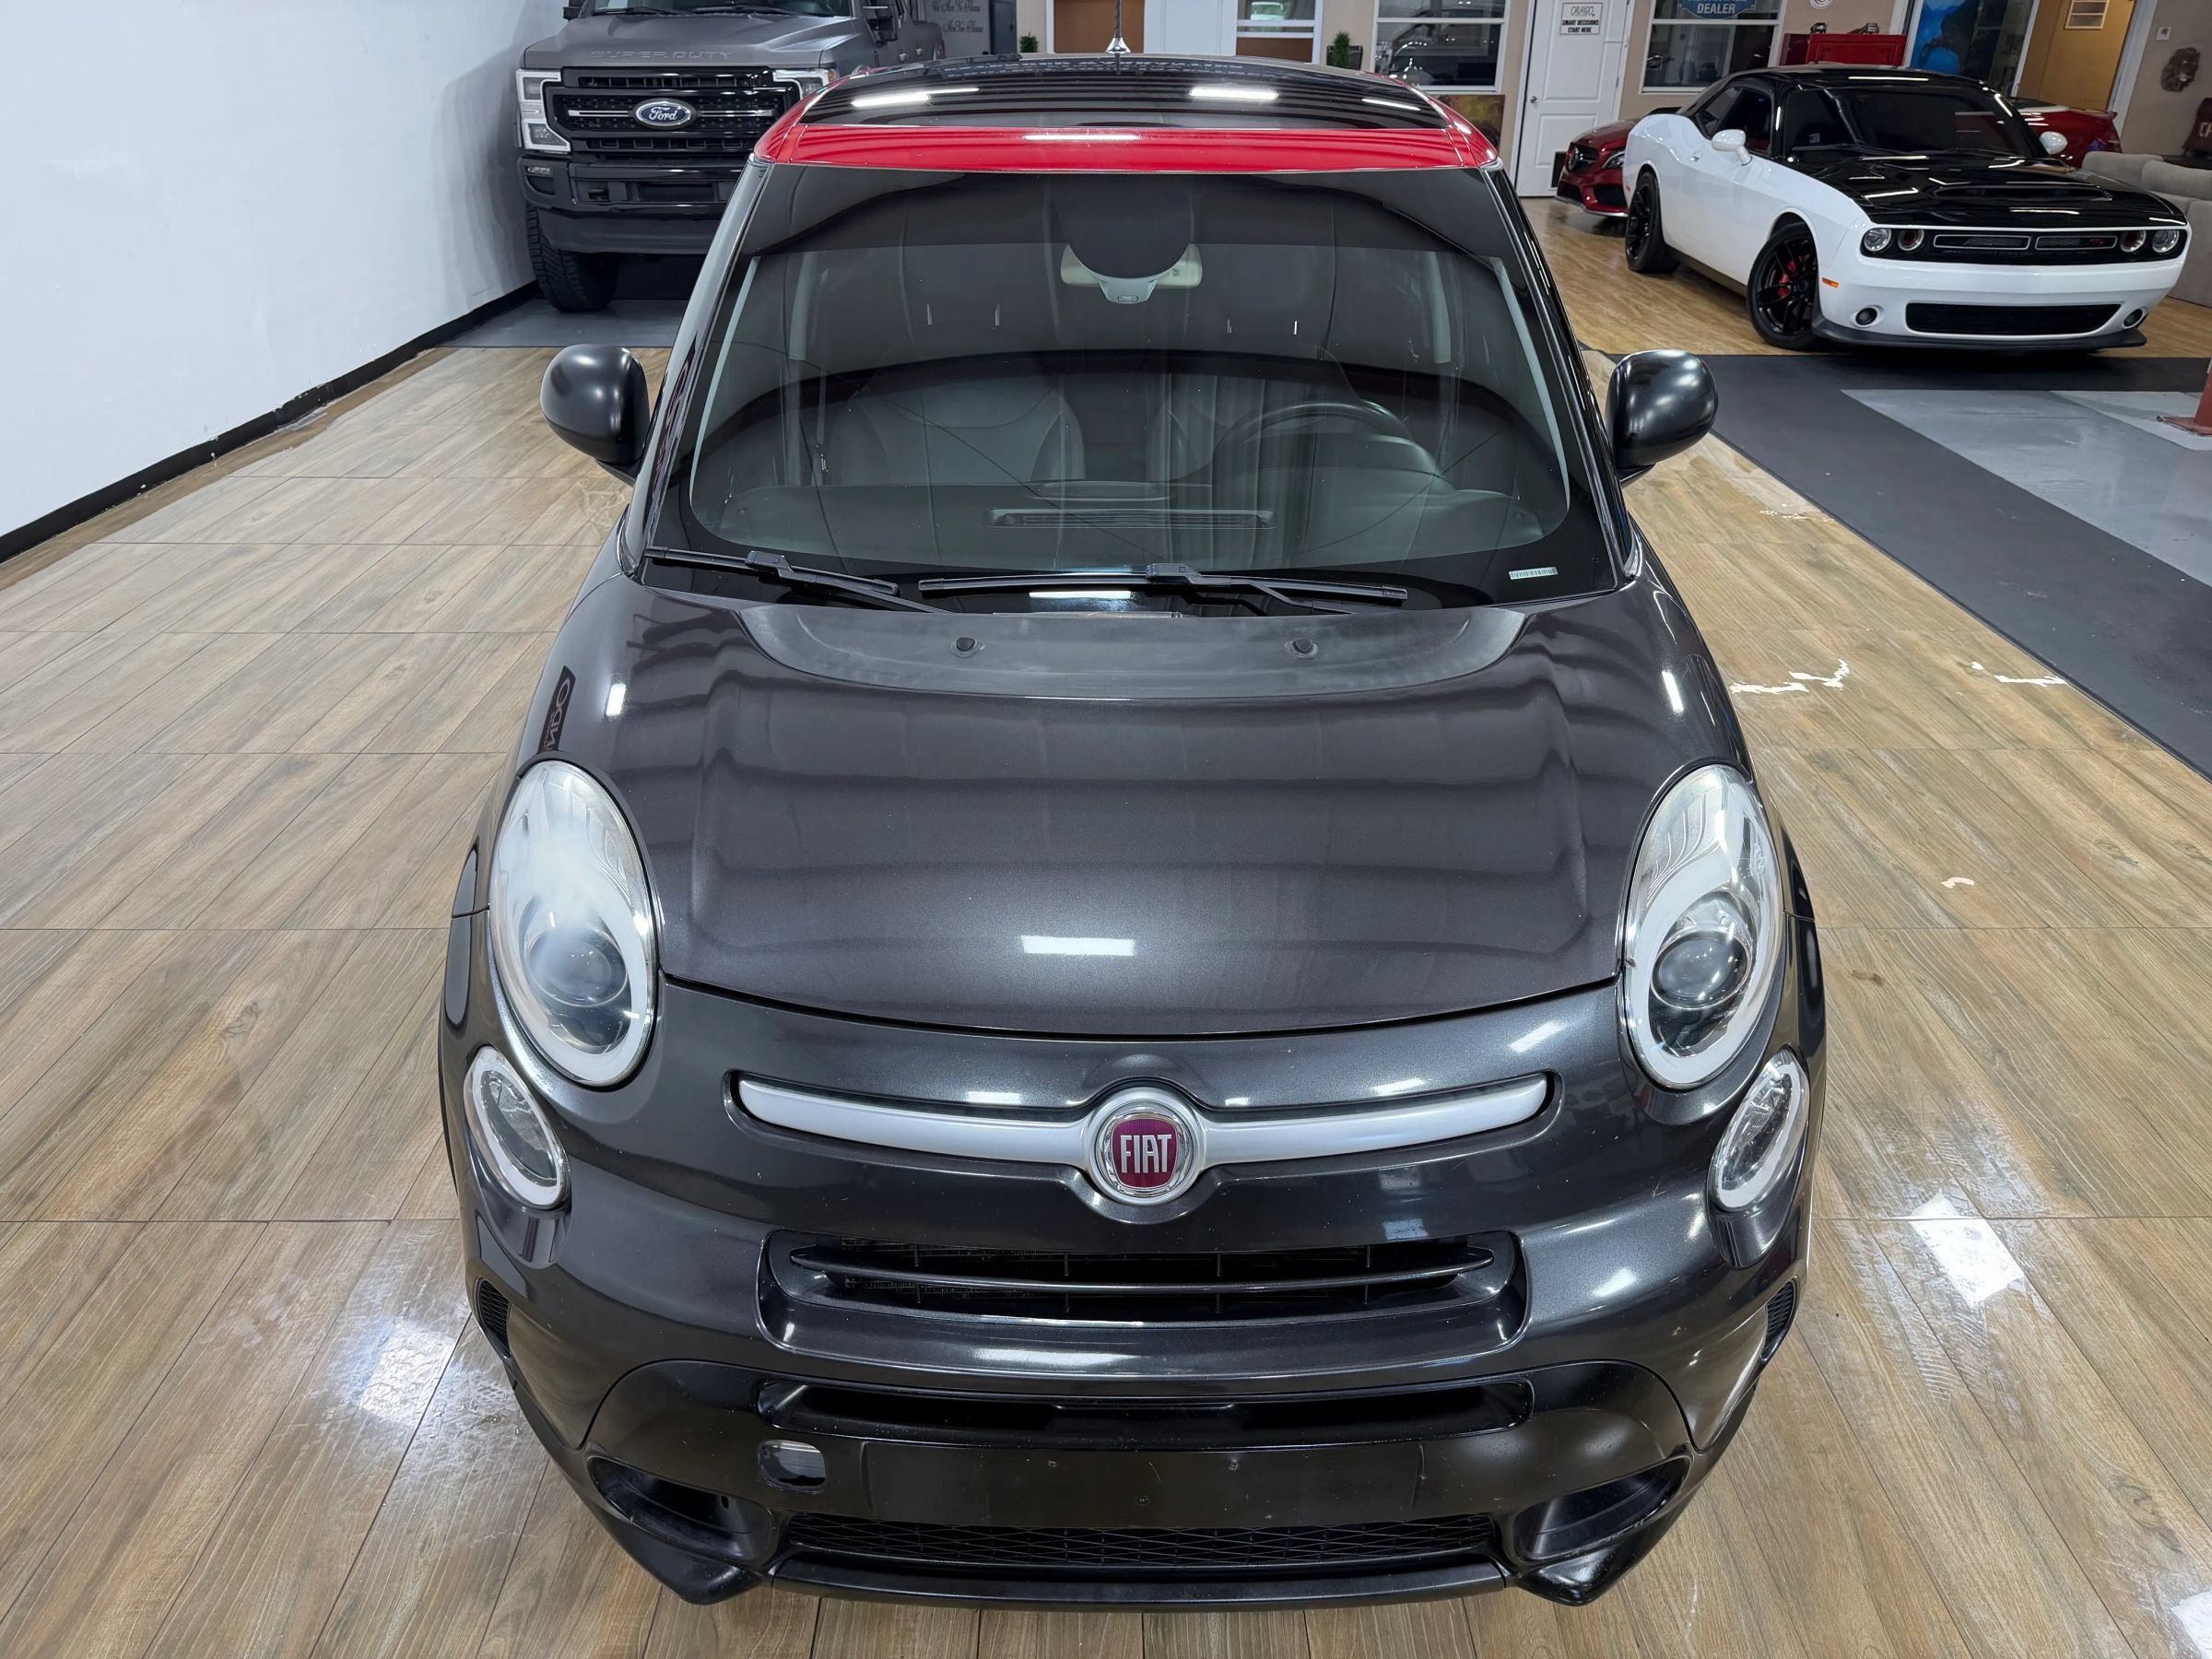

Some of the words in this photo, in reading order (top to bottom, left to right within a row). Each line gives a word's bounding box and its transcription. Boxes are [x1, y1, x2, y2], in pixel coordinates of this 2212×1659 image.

[1697, 3, 1735, 14] DEALER
[590, 51, 668, 59] SUPER
[673, 51, 734, 59] DUTY
[649, 106, 677, 120] Ford
[1120, 1134, 1172, 1173] FIAT
